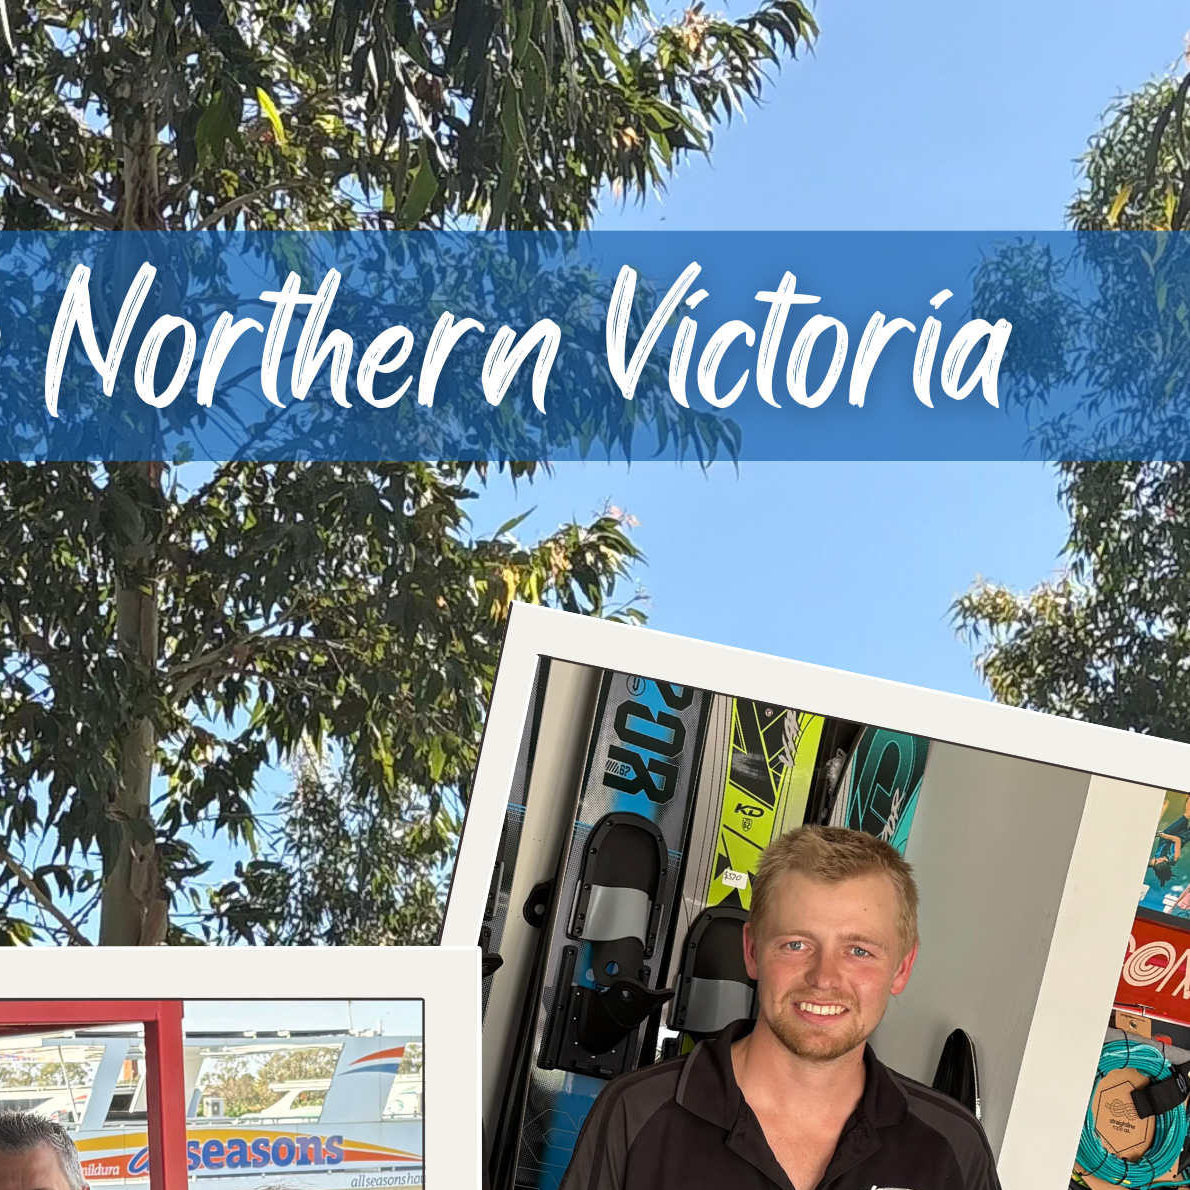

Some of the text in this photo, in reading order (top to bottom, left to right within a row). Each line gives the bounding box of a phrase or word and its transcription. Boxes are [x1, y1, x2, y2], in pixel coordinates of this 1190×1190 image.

[733, 802, 765, 818] KD
[1109, 1118, 1135, 1130] straightline
[187, 1134, 345, 1171] seasons
